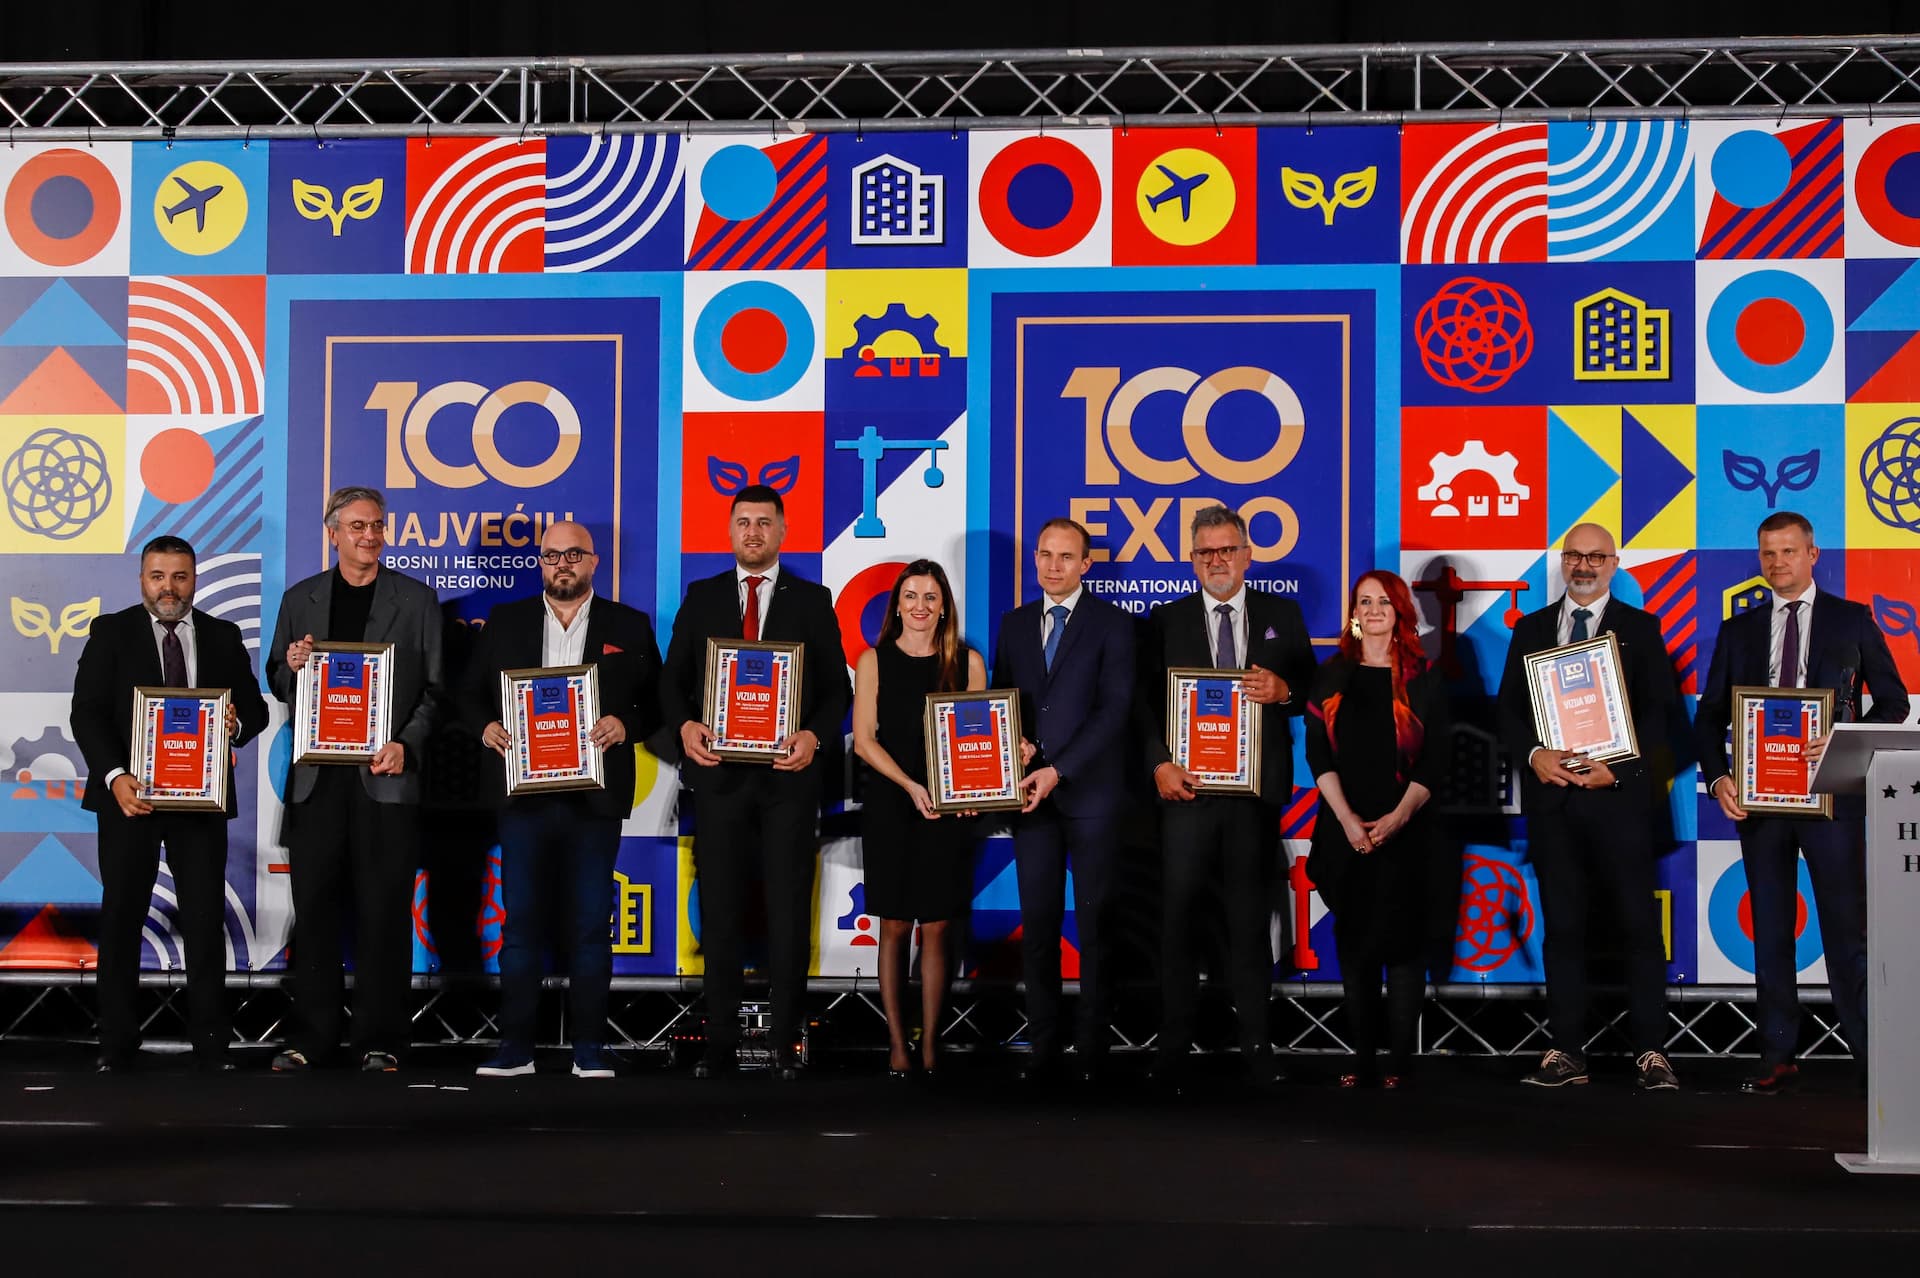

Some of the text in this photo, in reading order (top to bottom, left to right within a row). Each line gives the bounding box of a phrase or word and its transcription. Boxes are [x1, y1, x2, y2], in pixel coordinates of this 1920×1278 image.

[1060, 366, 1305, 485] 100
[364, 380, 582, 489] 100
[385, 555, 542, 569] BOSNI I HERCEGO
[436, 575, 515, 589] REGIONU
[1082, 579, 1199, 594] TERNATIONAL
[349, 695, 361, 704] 100
[757, 692, 770, 702] 100
[557, 719, 569, 729] 100
[1218, 723, 1230, 732] 100
[184, 740, 197, 750] 100
[979, 742, 992, 751] 100
[1787, 743, 1800, 753] 100
